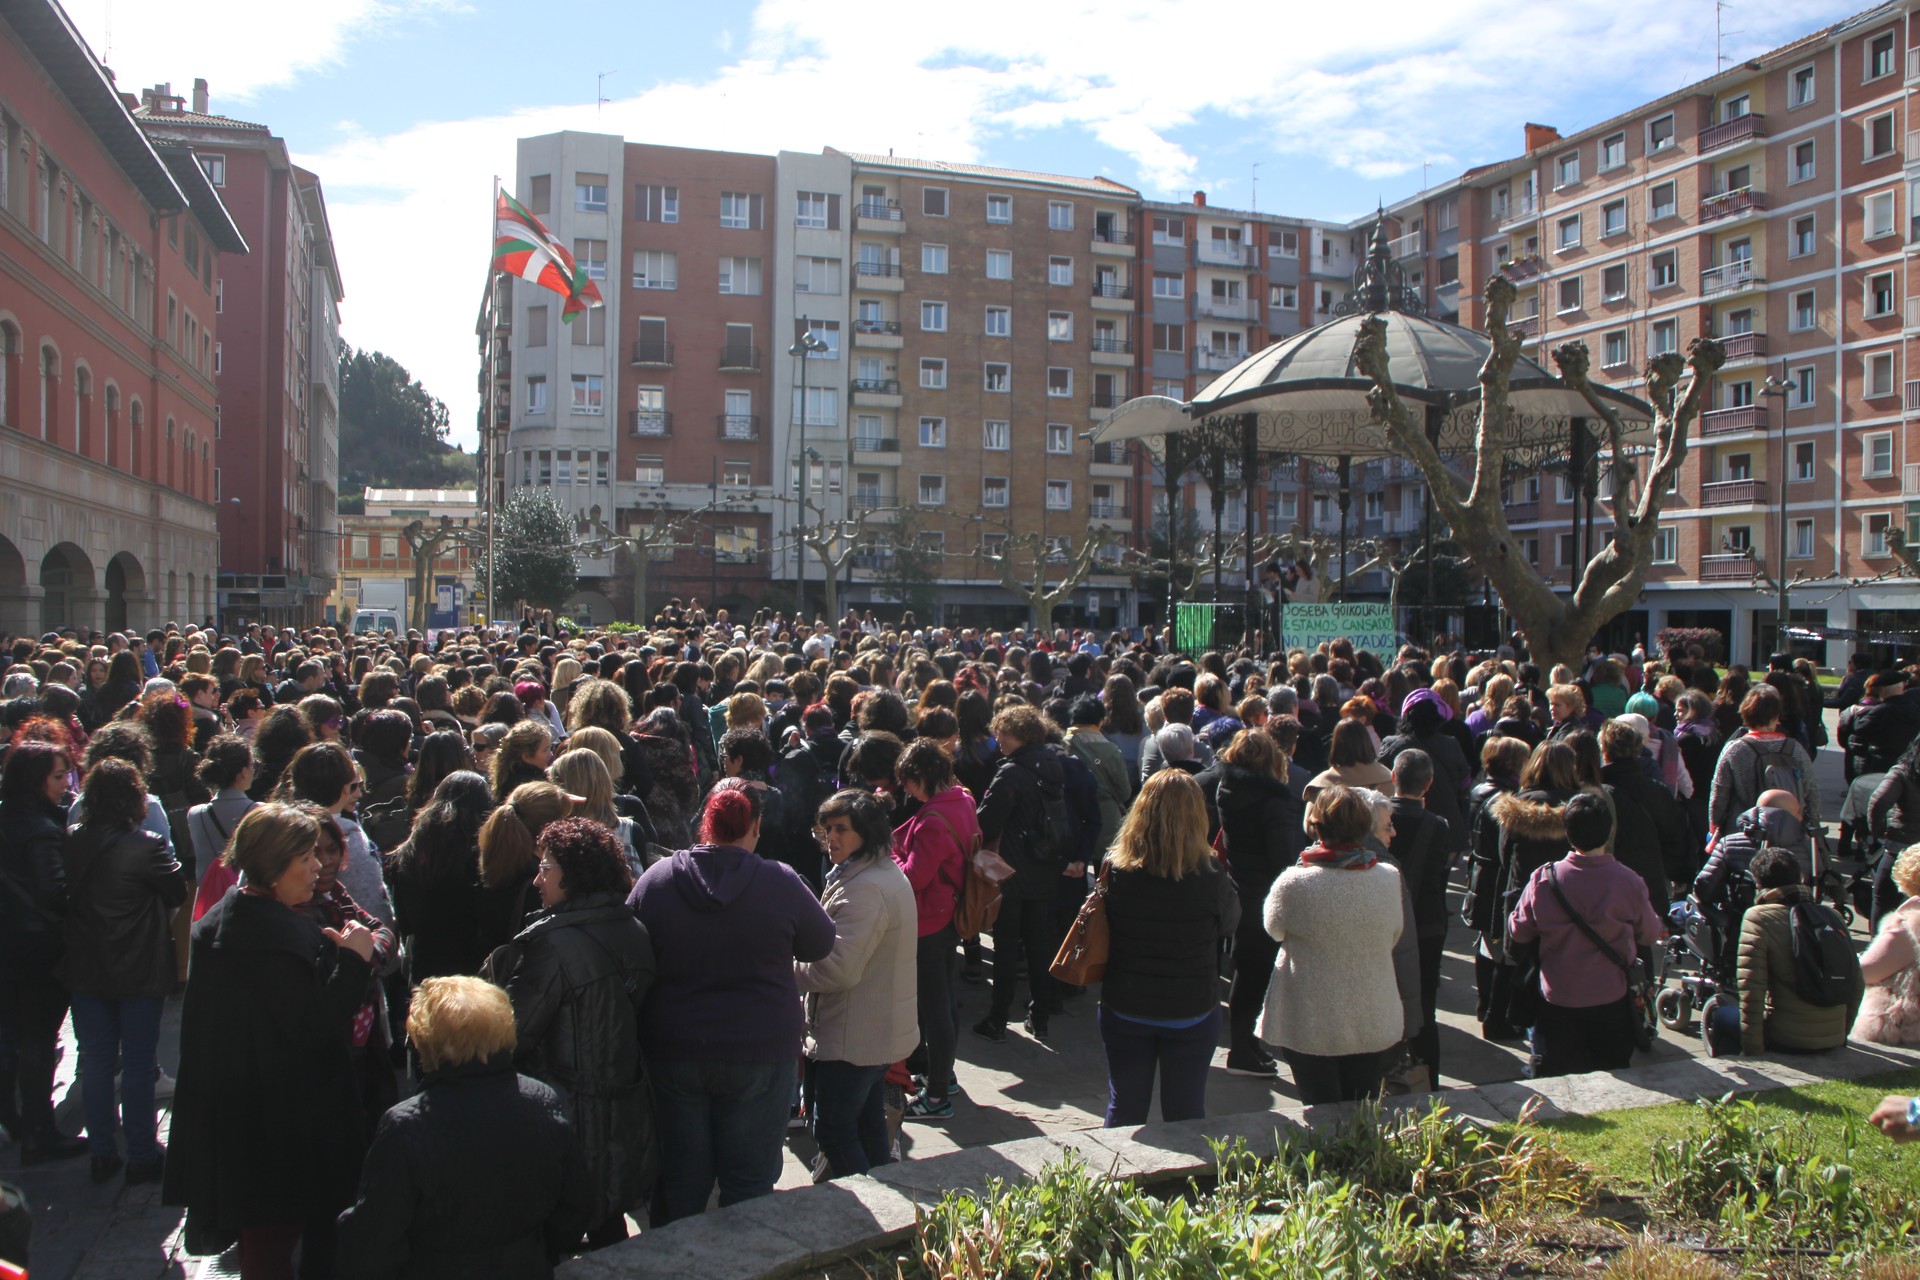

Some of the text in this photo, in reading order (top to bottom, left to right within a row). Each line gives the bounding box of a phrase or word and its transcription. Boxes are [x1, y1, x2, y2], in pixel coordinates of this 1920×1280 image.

[1286, 603, 1329, 616] JOSEBA
[1284, 618, 1393, 631] ESTAMOS CANSADOS
[1282, 634, 1300, 648] NO
